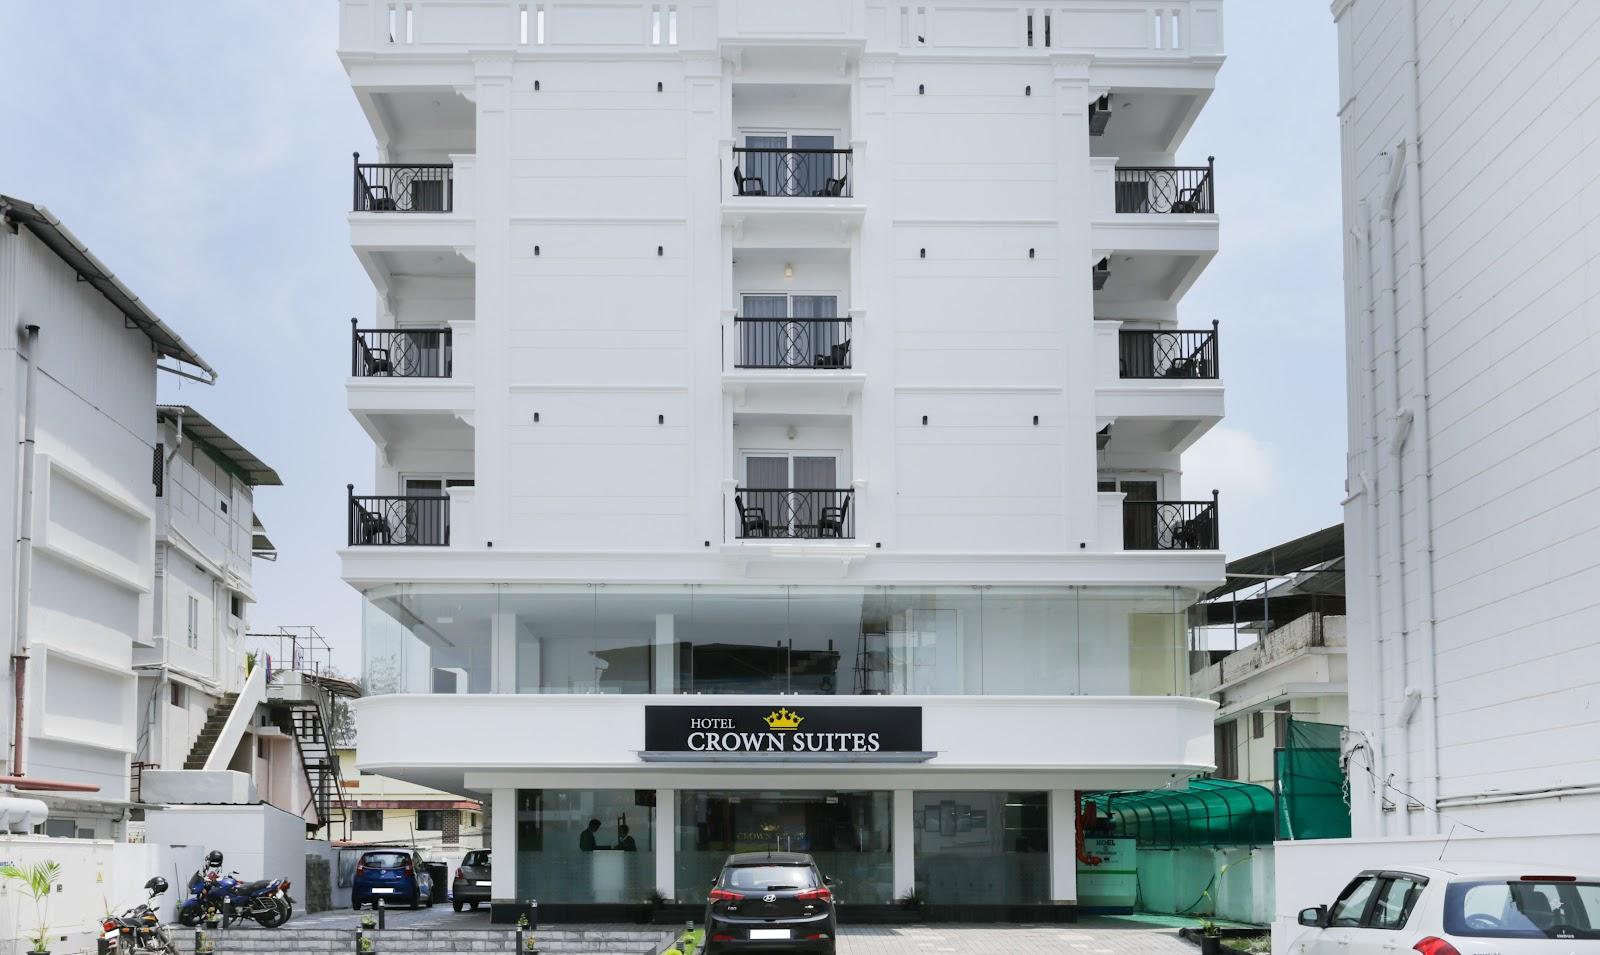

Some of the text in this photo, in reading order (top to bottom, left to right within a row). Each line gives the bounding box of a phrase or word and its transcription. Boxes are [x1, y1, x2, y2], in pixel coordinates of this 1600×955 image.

[691, 718, 735, 729] HOTEL
[687, 732, 880, 752] CROWN SUITES
